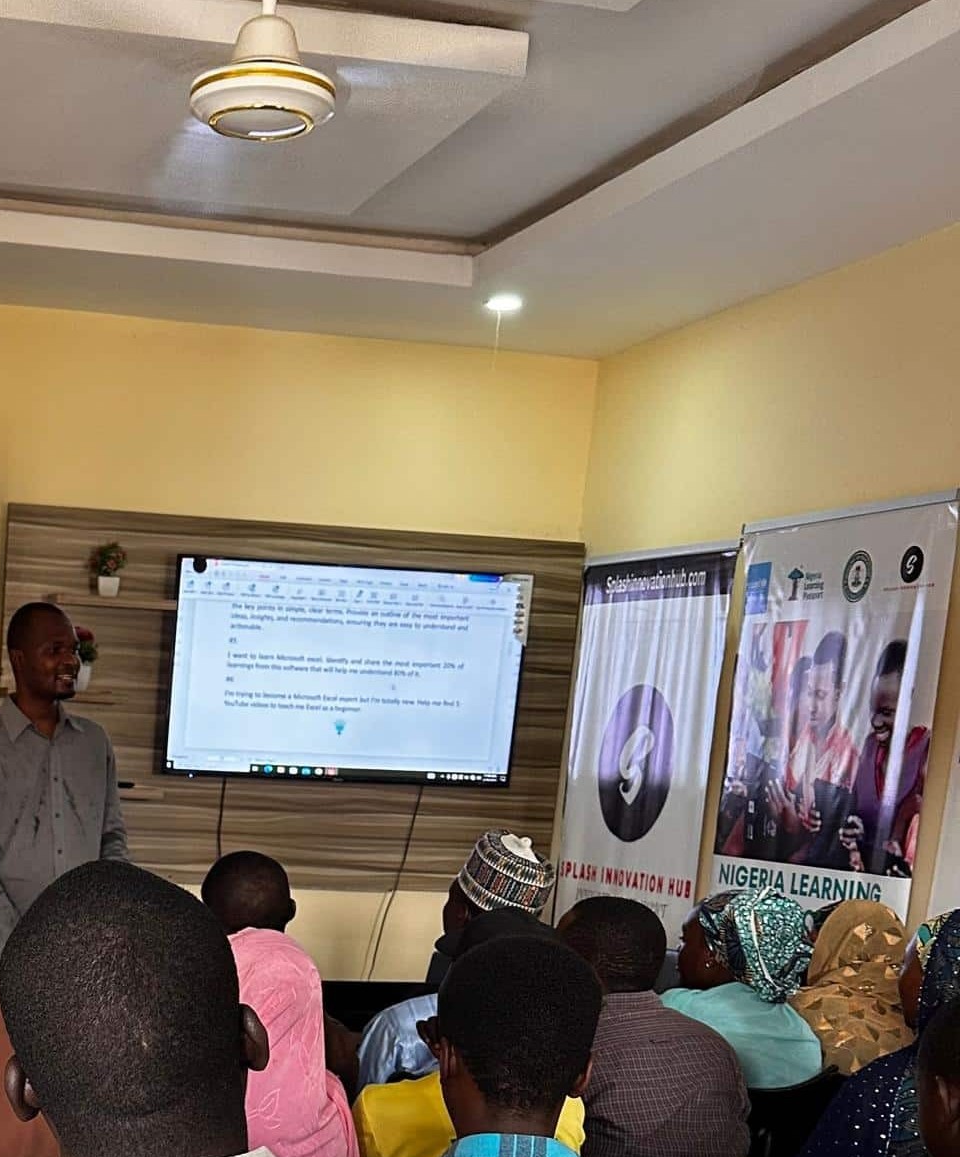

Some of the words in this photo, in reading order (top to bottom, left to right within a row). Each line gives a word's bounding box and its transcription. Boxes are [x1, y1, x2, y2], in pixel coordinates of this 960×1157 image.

[606, 568, 707, 594] Splashinnovationhub.com
[560, 860, 597, 882] SPLASH
[600, 866, 664, 894] INNOVATION
[668, 877, 692, 899] HUB
[718, 863, 785, 893] NIGERIA
[790, 872, 881, 902] LEARNING
